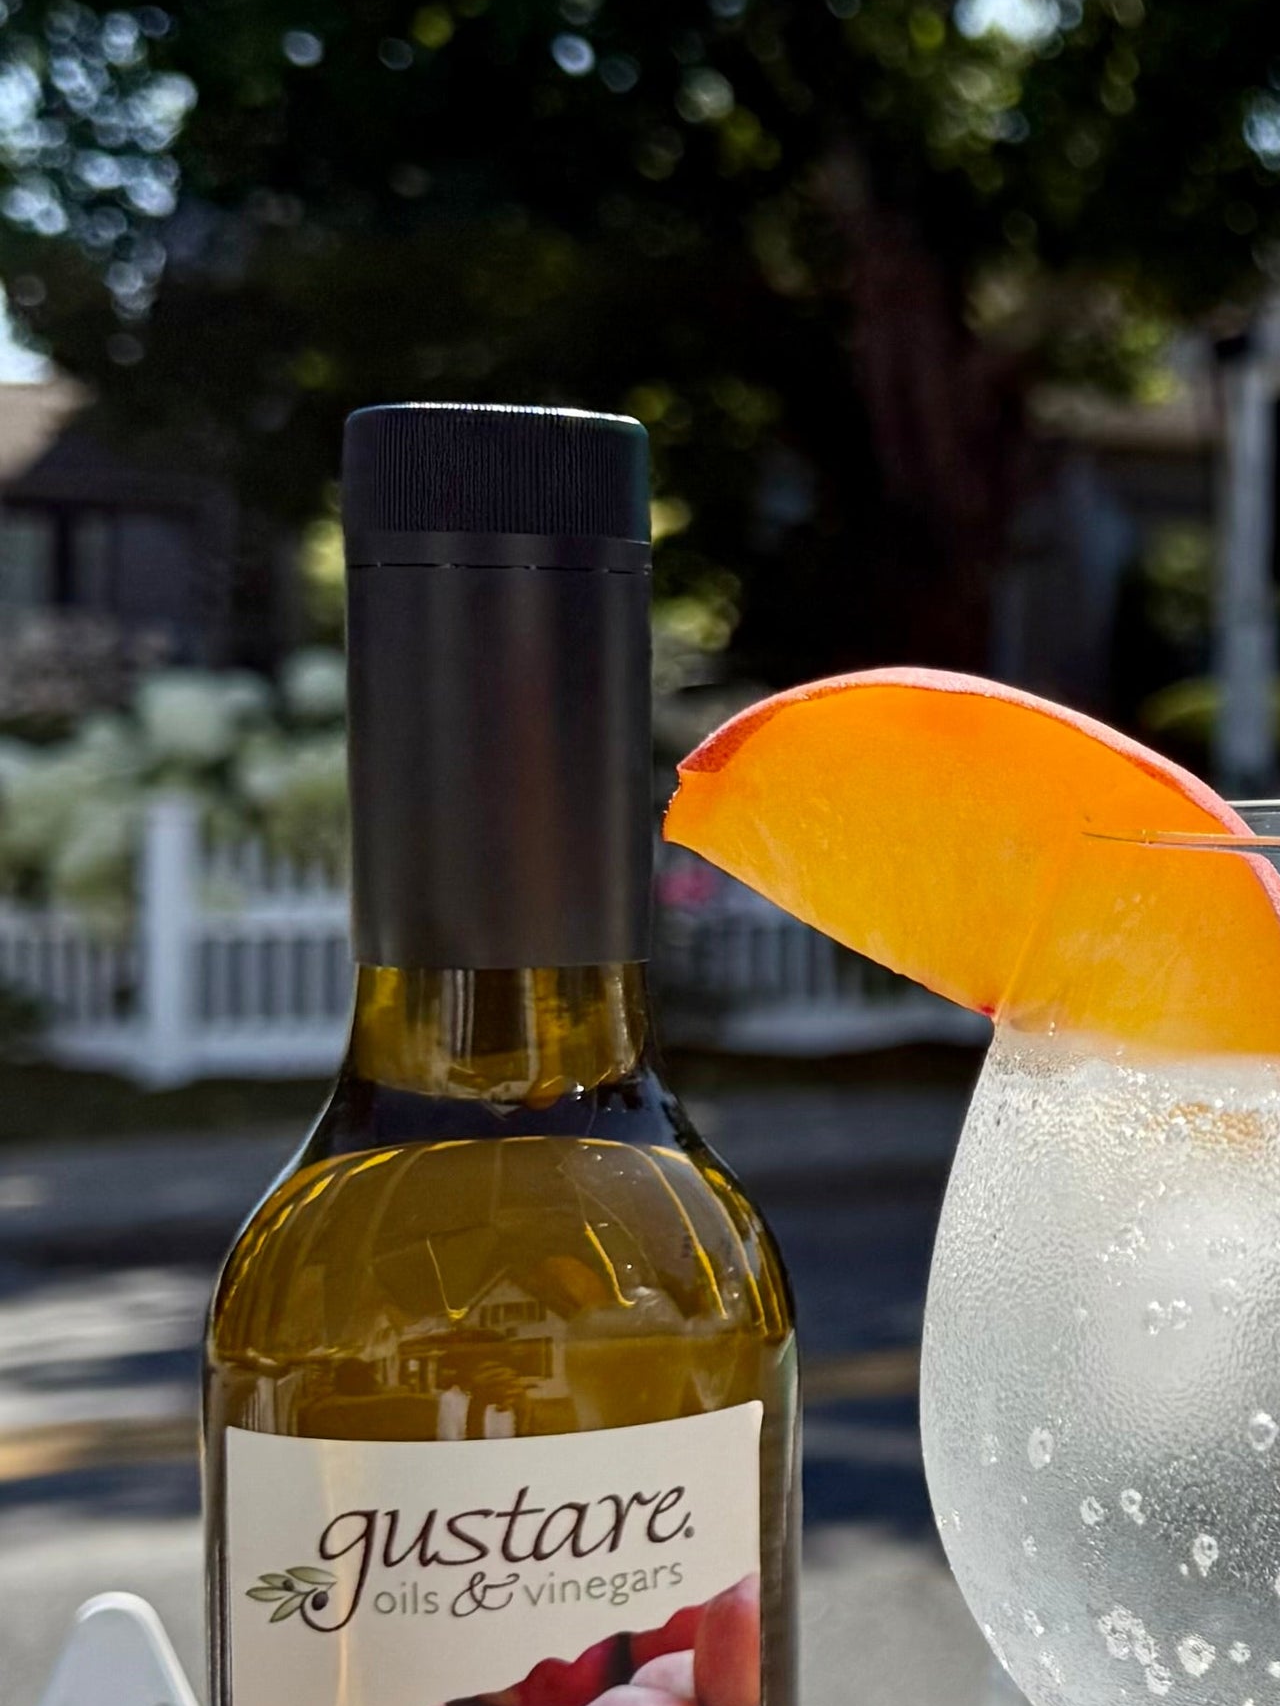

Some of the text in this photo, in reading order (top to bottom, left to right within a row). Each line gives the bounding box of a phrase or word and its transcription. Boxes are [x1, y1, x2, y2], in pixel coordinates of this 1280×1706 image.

[374, 1561, 684, 1618] oils & vinegars
